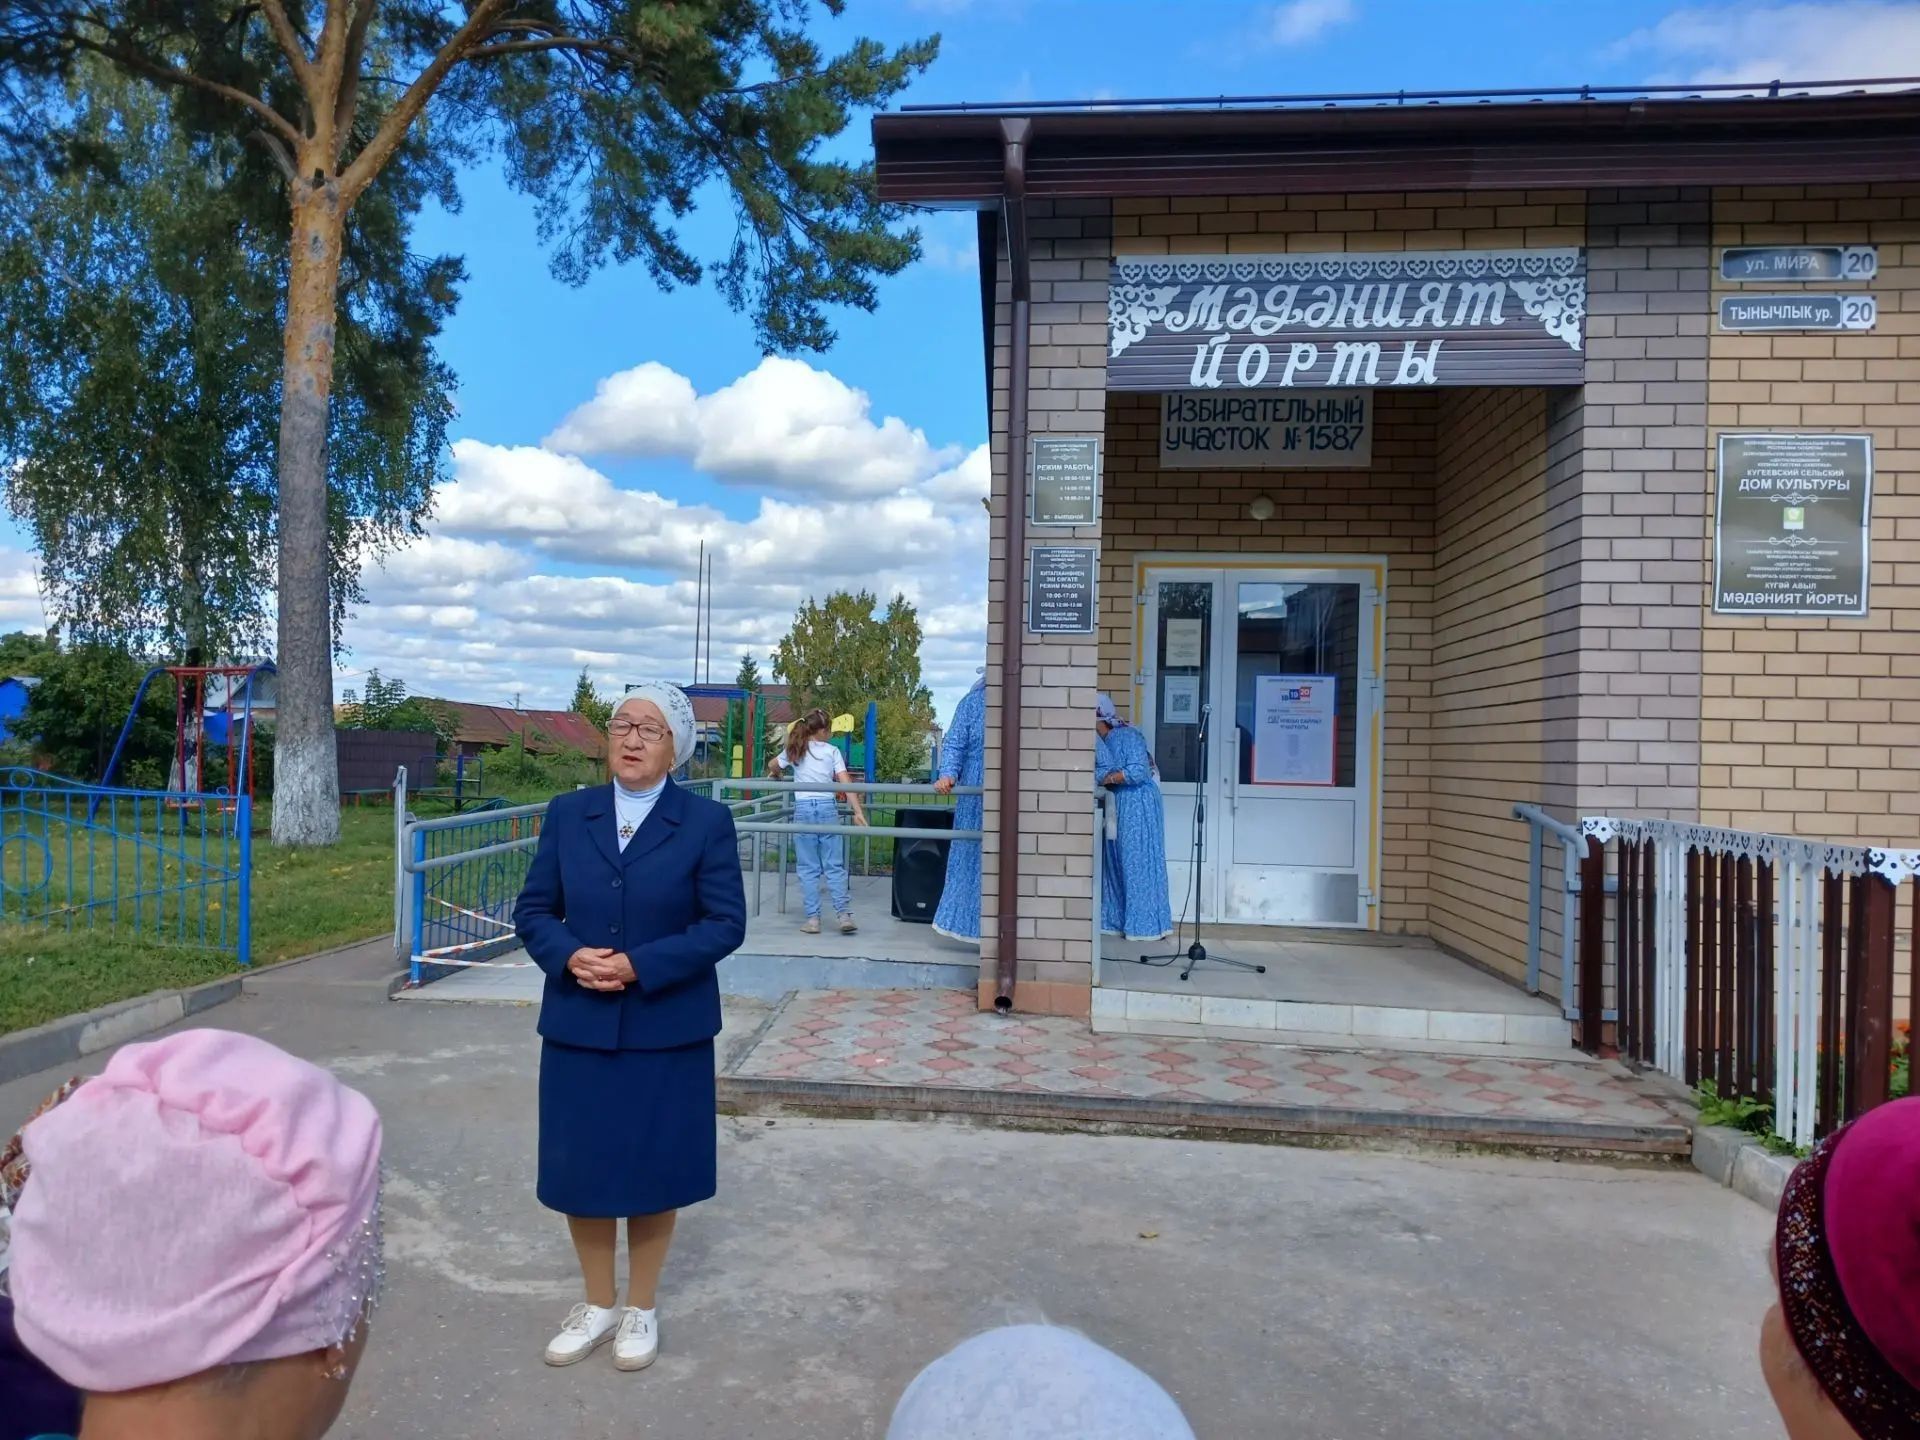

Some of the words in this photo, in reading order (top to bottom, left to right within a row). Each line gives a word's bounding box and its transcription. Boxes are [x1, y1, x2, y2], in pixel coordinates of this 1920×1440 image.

[1745, 260, 1770, 273] ул.
[1774, 256, 1820, 270] МИРА
[1847, 253, 1874, 273] 20
[1730, 305, 1812, 320] ТЫНЫЧЛЫК
[1815, 308, 1833, 322] ур.
[1846, 303, 1873, 322] 20
[1801, 468, 1845, 477] СЕЛЬСКИЙ
[1739, 478, 1772, 491] ДОМ
[1776, 478, 1850, 491] КУЛЬТУРЫ
[1723, 592, 1802, 606] МӘДӘНИЯТ
[1806, 591, 1857, 605] ЙОРТЫ
